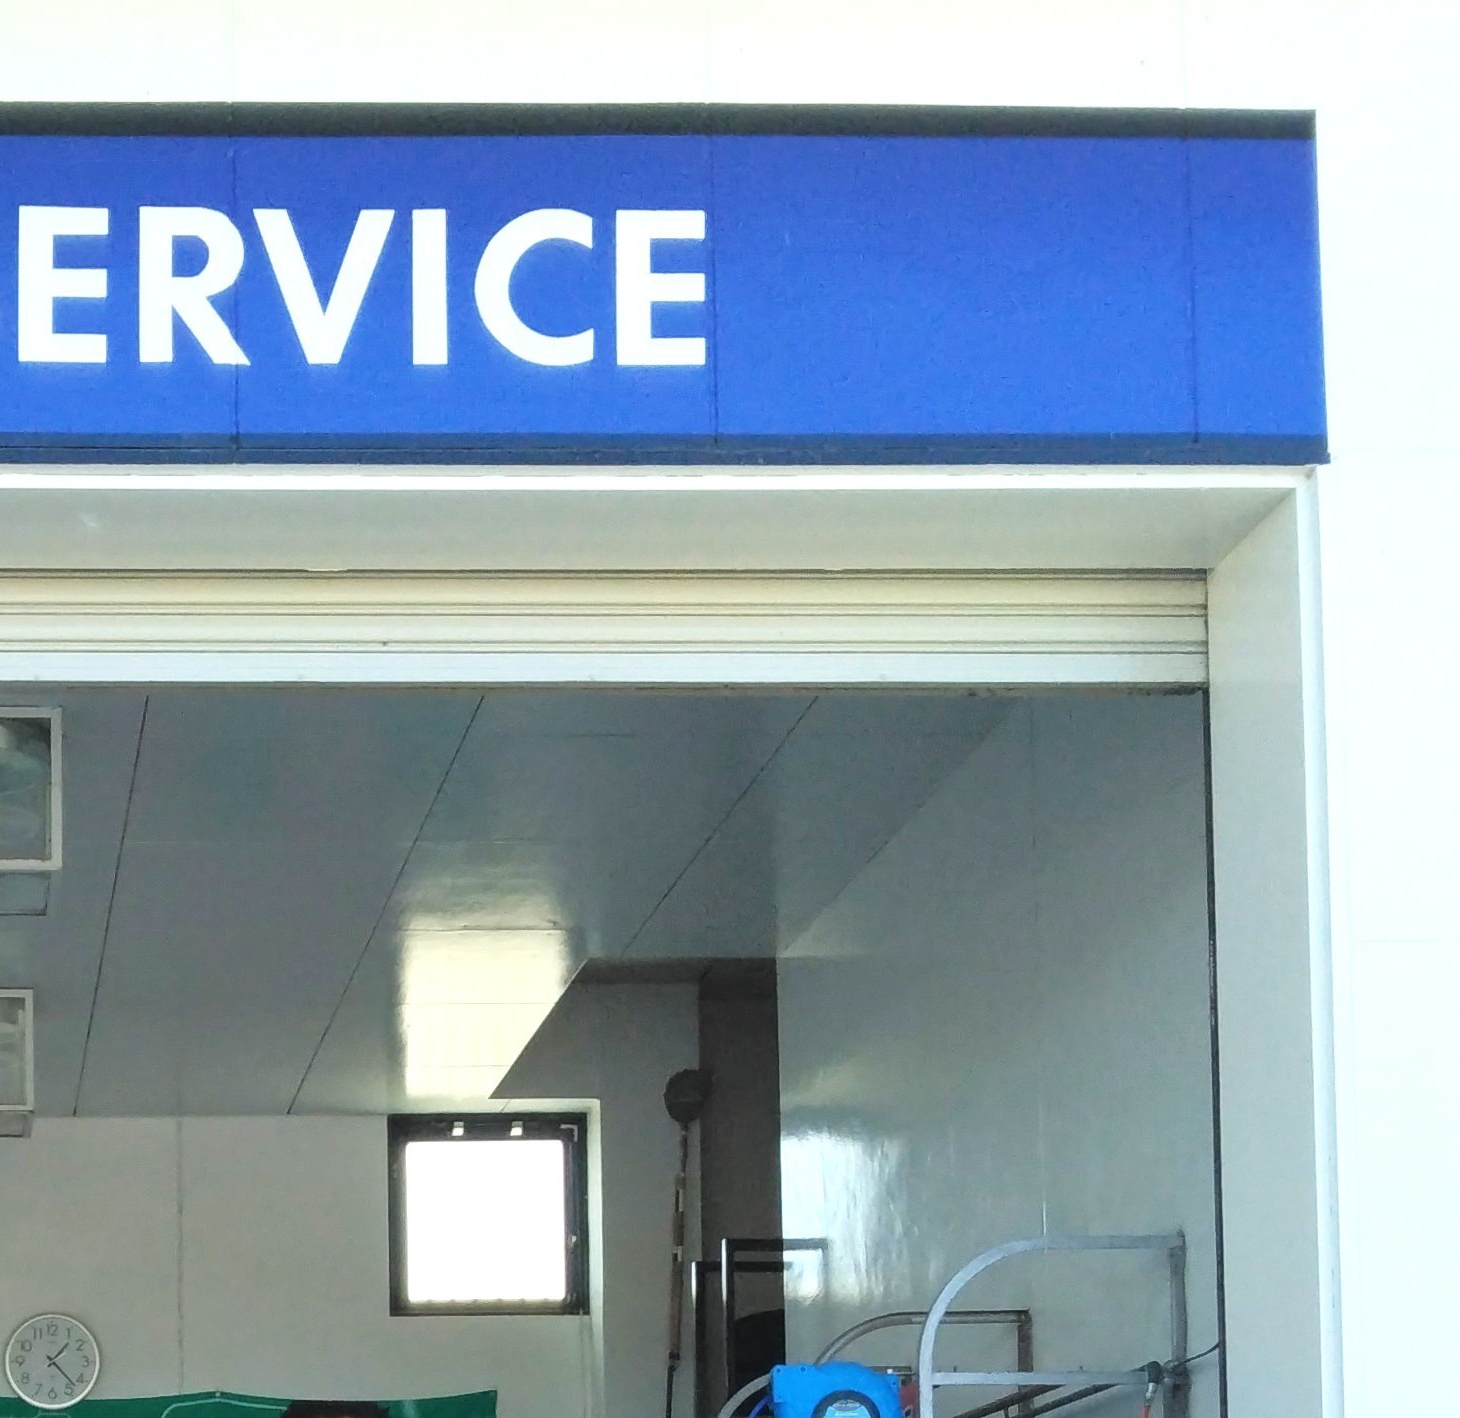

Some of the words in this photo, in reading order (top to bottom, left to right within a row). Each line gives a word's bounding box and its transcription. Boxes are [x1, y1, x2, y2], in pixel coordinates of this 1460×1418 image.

[32, 1326, 43, 1340] 11
[46, 1324, 58, 1337] 12
[66, 1327, 73, 1339] 1
[20, 1340, 33, 1353] 10
[75, 1339, 85, 1352] 2
[15, 1356, 25, 1368] 9
[81, 1356, 90, 1368] 3
[20, 1372, 30, 1384] 8
[76, 1373, 84, 1384] 4
[34, 1383, 43, 1396] 7
[48, 1388, 58, 1400] 6
[63, 1384, 74, 1396] 5
